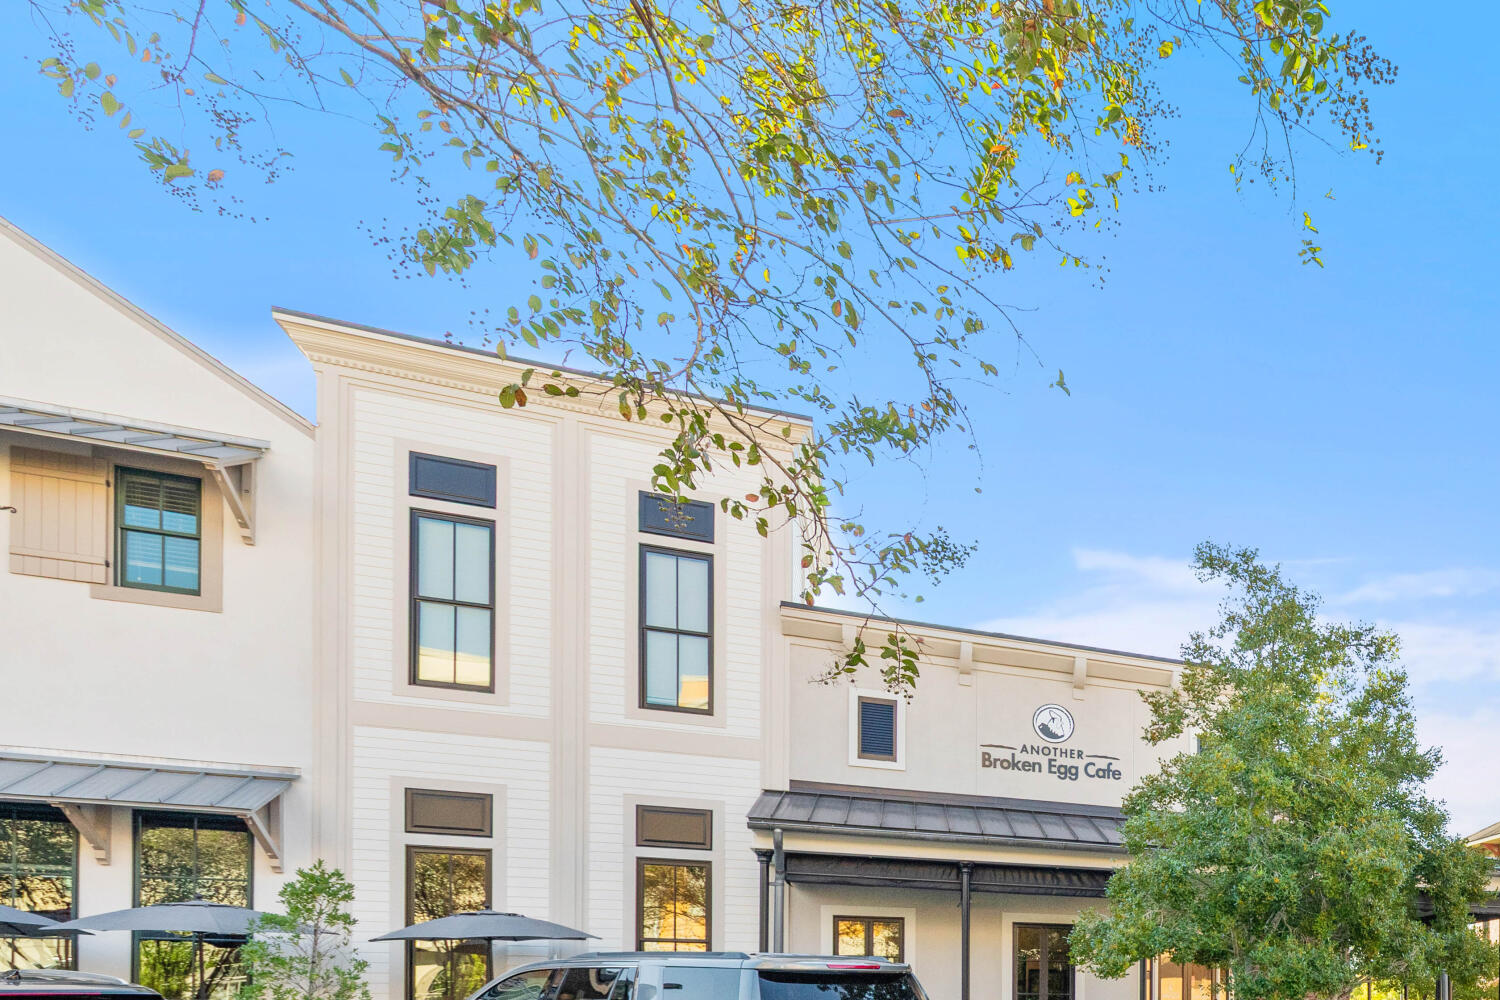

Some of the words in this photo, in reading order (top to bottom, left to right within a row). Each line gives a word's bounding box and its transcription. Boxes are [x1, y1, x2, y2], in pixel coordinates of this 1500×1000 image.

[1020, 744, 1084, 760] ANOTHER
[981, 751, 1042, 773] Broken
[1047, 758, 1079, 781] Egg
[1084, 761, 1122, 781] Cafe
